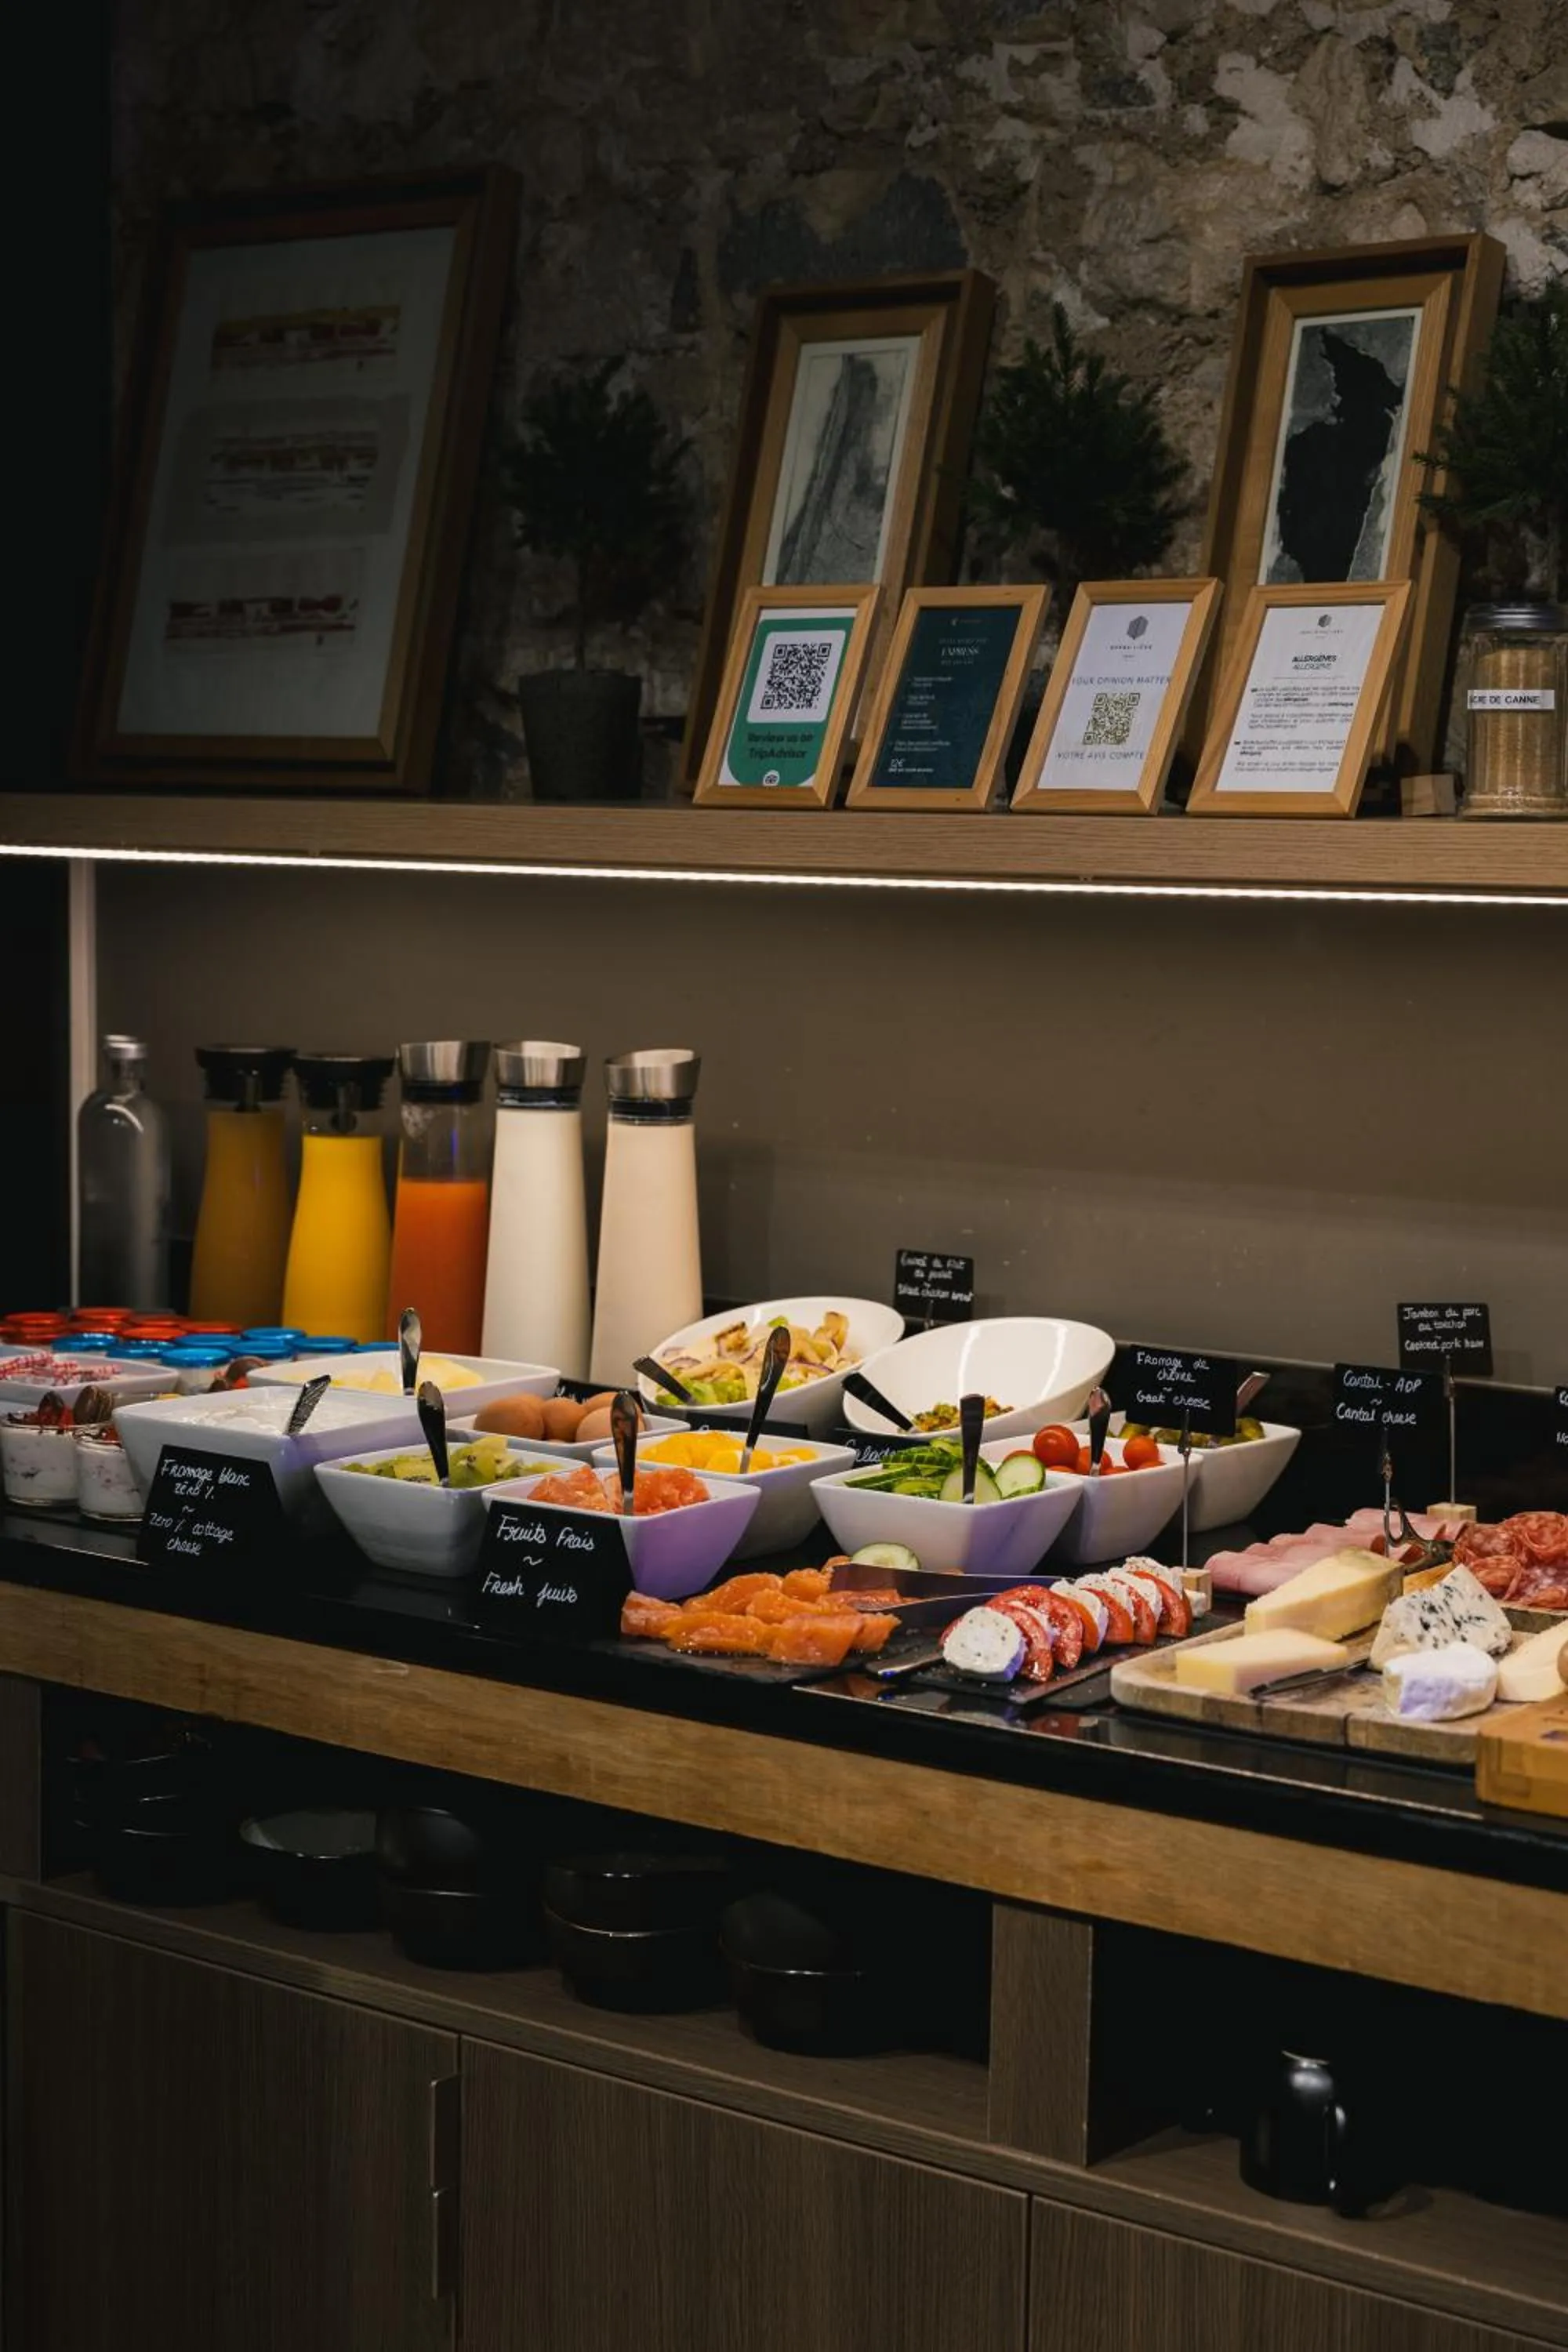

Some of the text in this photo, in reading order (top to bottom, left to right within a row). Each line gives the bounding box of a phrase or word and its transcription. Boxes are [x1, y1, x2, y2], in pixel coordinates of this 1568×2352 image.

[1097, 677, 1133, 685] OPINION
[1505, 695, 1541, 704] CANNE
[1395, 1377, 1423, 1393] AOP
[1336, 1402, 1376, 1421] Cantal
[218, 1467, 250, 1486] blanc
[192, 1520, 234, 1544] cottage
[496, 1514, 547, 1544] Fruits
[166, 1537, 202, 1555] cheese
[481, 1570, 524, 1595] Fresh
